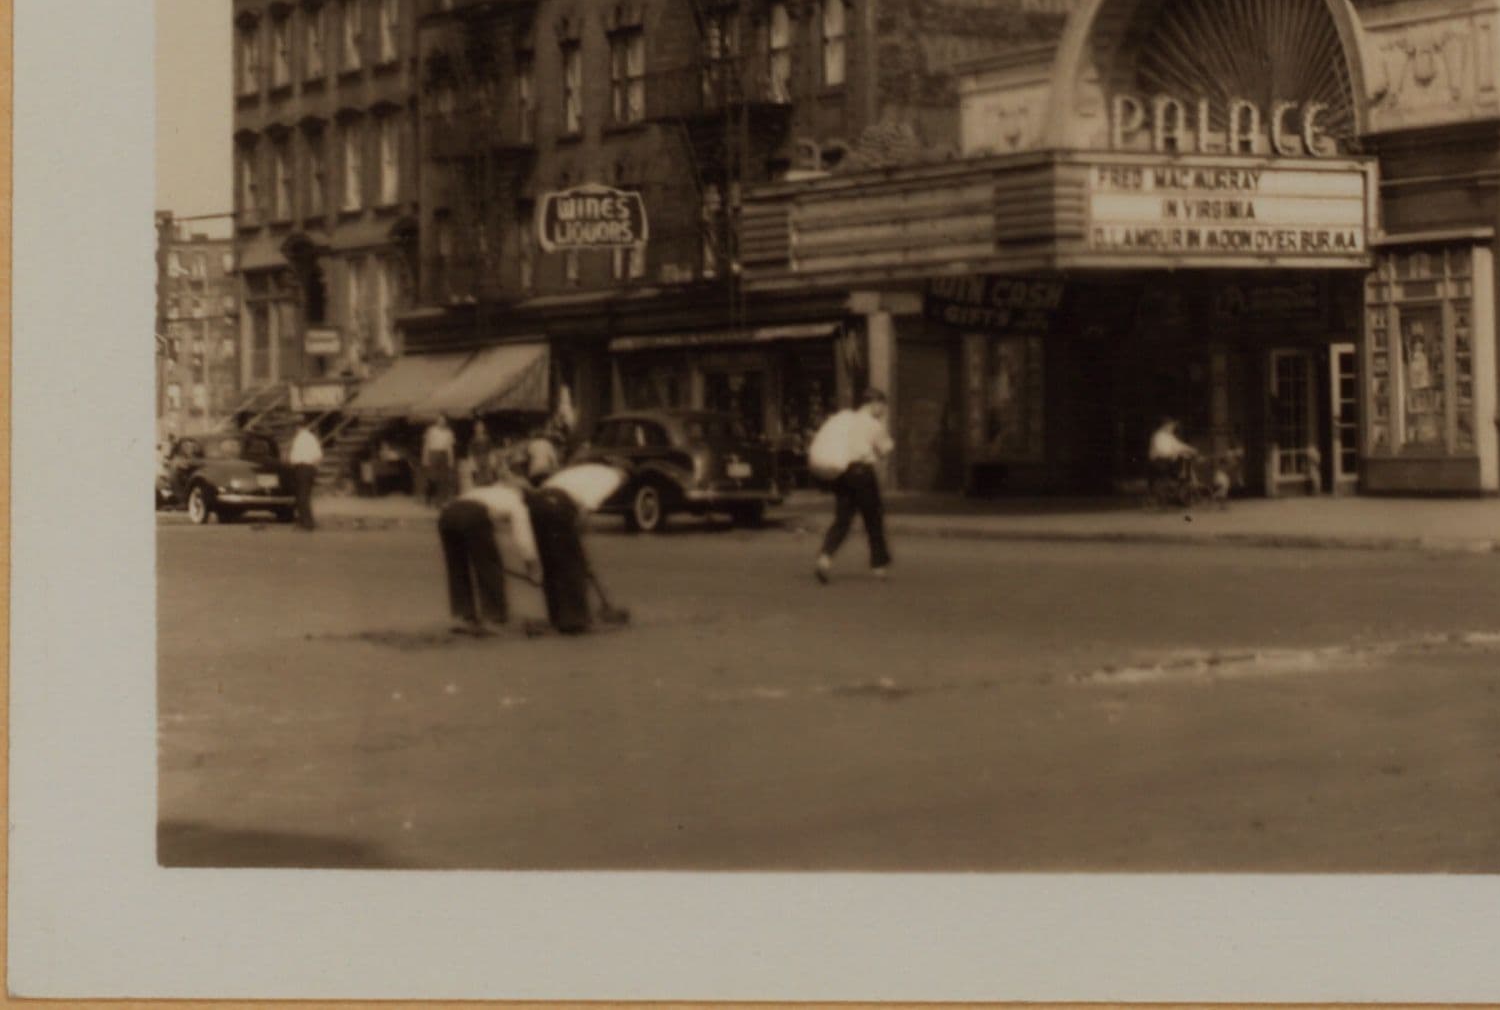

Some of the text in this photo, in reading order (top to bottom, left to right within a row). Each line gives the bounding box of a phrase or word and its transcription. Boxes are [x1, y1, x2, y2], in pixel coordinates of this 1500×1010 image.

[1112, 92, 1330, 158] PALACE
[1096, 166, 1144, 190] FRED
[556, 197, 631, 220] WINES
[1161, 198, 1257, 220] IN VIRGINIA
[555, 221, 635, 245] LIQUORS
[1206, 229, 1253, 250] MOON
[1255, 230, 1298, 252] OVER
[992, 280, 1065, 309] CASH
